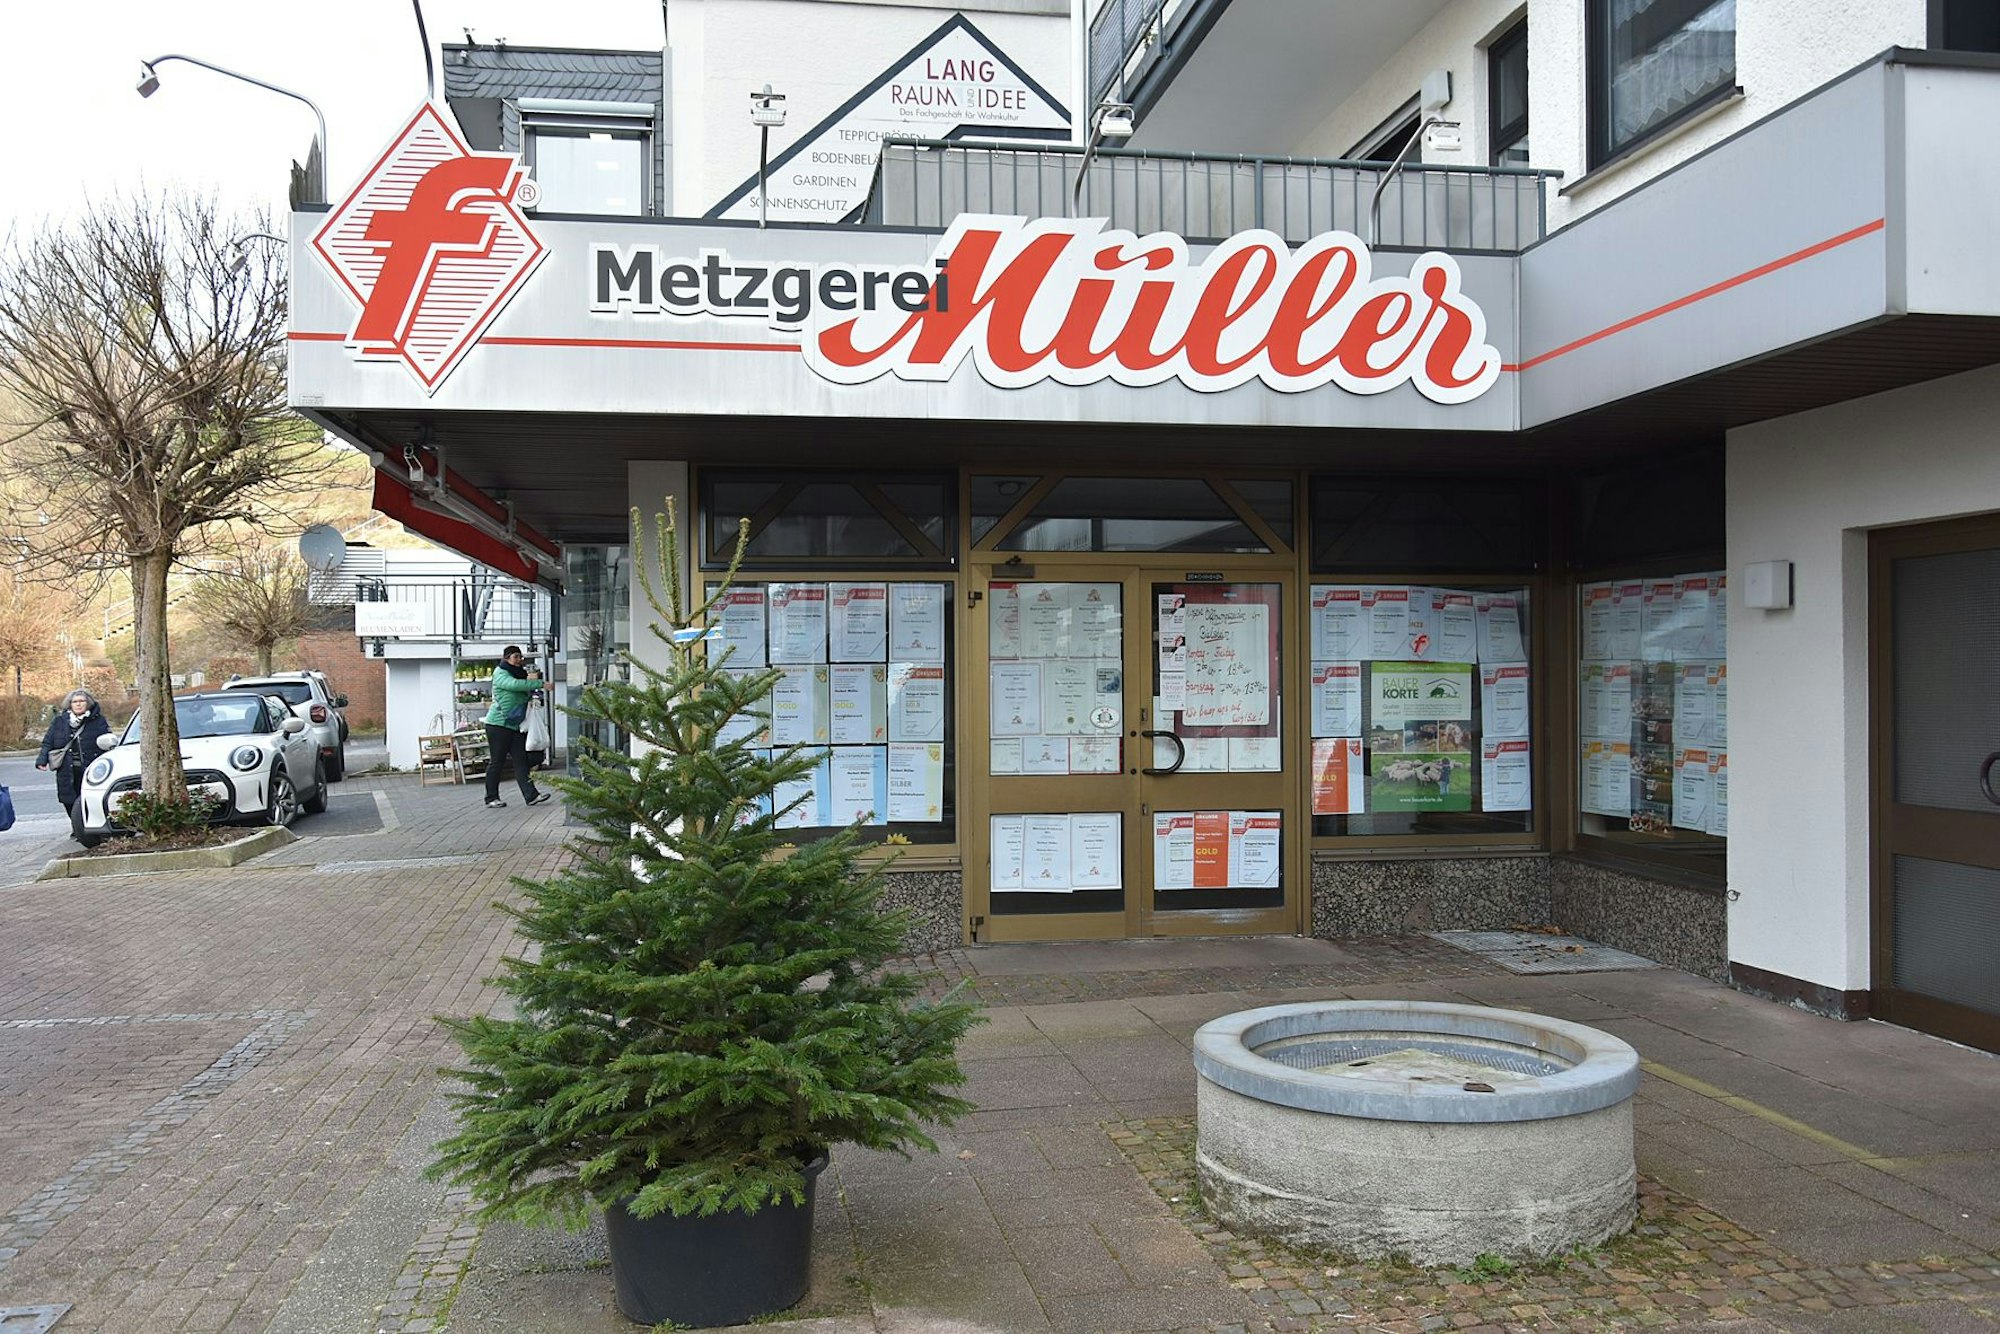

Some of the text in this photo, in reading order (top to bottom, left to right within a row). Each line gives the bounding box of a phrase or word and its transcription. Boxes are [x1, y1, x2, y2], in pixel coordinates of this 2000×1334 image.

[927, 58, 995, 82] LANG
[892, 84, 957, 106] RAUM
[978, 88, 1026, 110] IDEE
[899, 108, 1019, 121] Das Fachgeschäft für Wohnkultur
[792, 174, 857, 188] GARDINEN
[598, 230, 1487, 388] Metzgerei Müller
[360, 625, 422, 633] BLUMENLADEN
[1382, 677, 1418, 689] BAUER
[1382, 688, 1419, 699] KORTE
[890, 780, 912, 788] SILBER
[1195, 847, 1219, 855] GOLD
